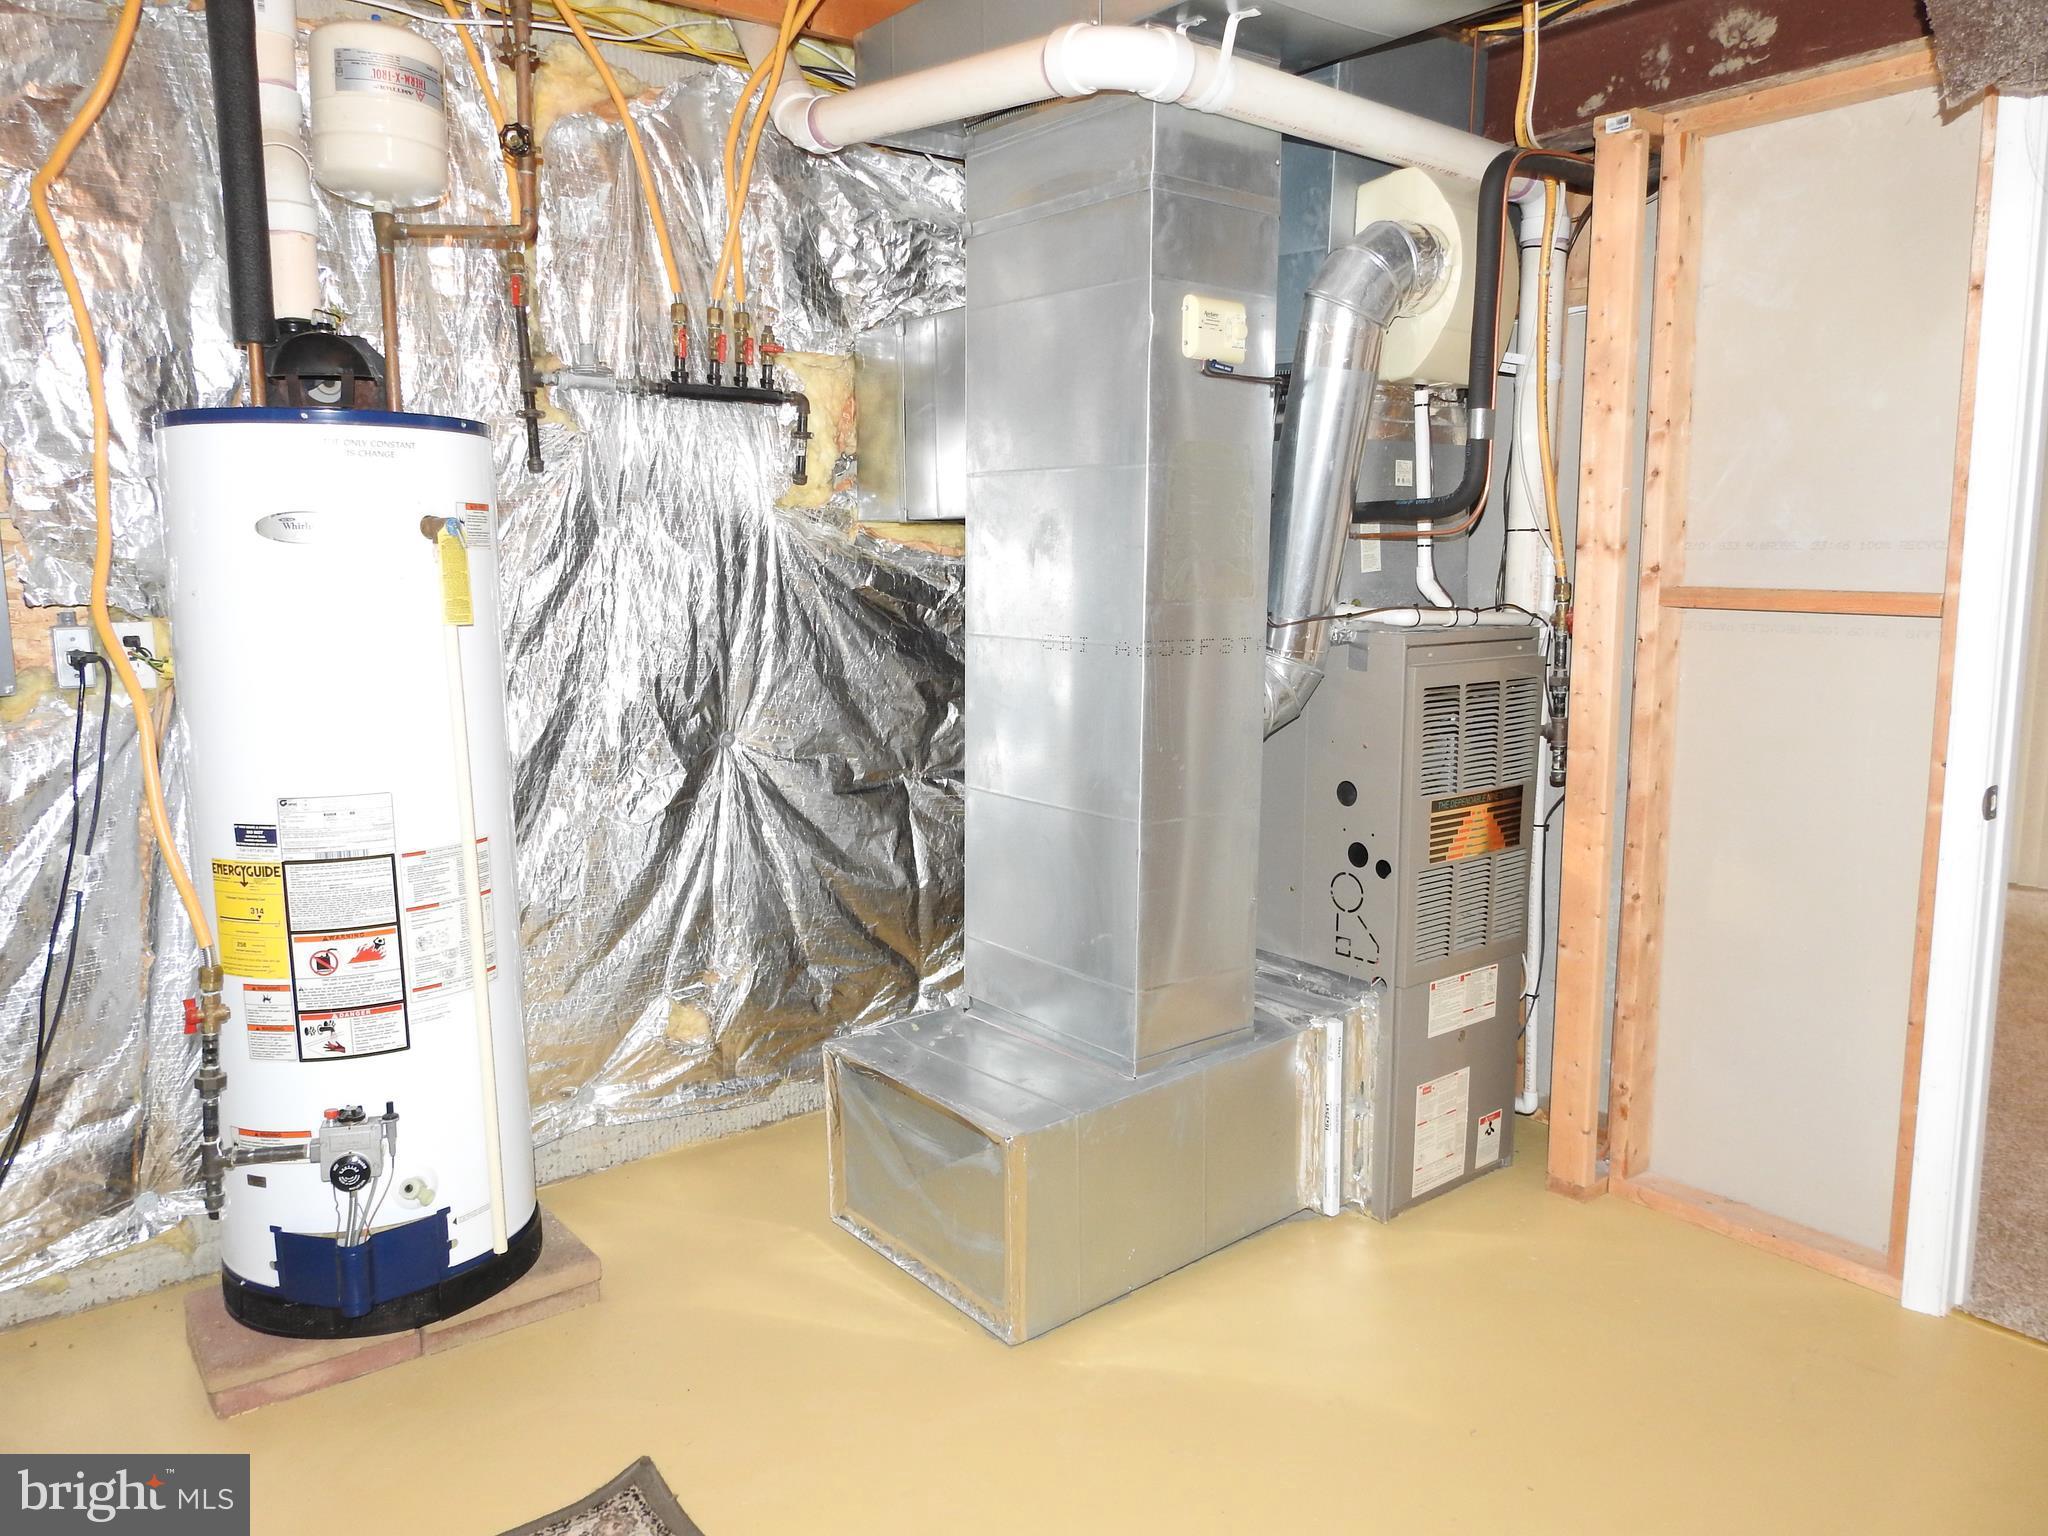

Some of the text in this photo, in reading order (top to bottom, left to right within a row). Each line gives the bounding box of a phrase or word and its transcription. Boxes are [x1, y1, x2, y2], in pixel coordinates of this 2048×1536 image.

[370, 440, 416, 449] CONSTANT
[358, 449, 395, 458] CHANGE
[283, 521, 312, 530] Whirl
[212, 862, 281, 879] ENERGYGUIDE
[250, 907, 264, 915] 314
[329, 932, 365, 941] WARNING
[339, 1009, 371, 1019] DANGER
